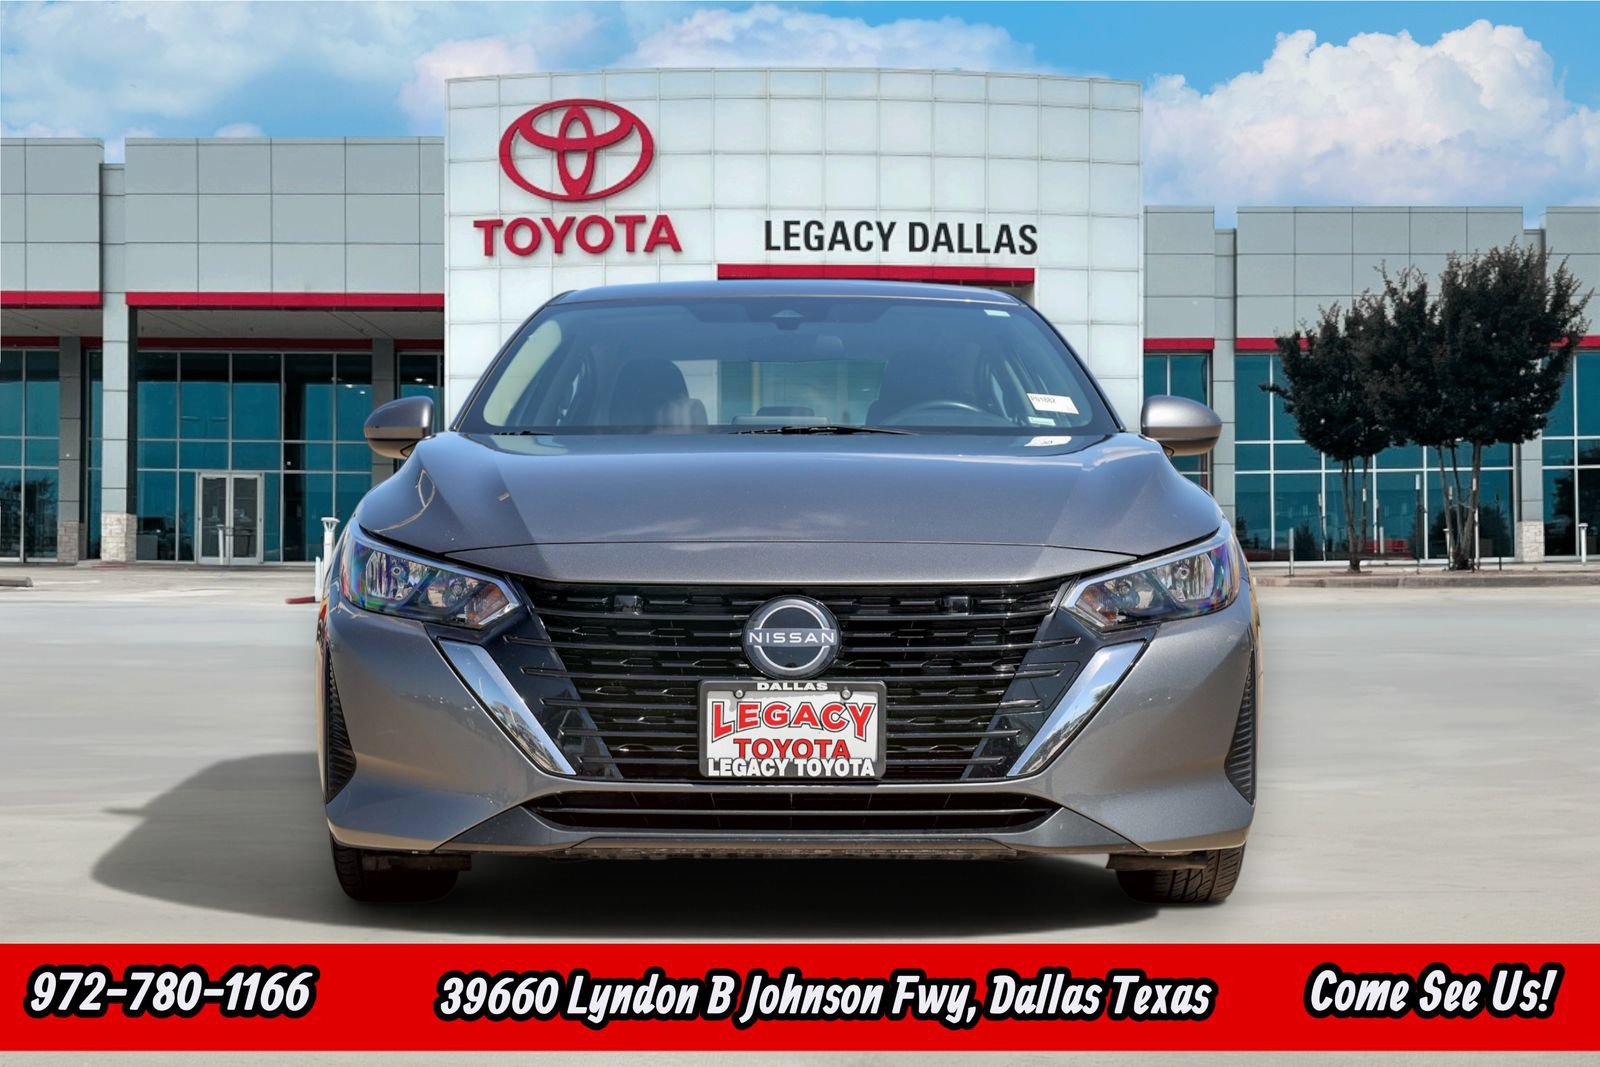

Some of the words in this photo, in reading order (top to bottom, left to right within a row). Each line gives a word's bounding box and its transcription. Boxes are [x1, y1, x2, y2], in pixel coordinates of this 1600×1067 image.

[473, 214, 683, 257] TOYOTA
[764, 220, 896, 251] LEGACY
[908, 221, 1038, 255] DALLAS
[749, 632, 835, 644] NISSAN
[757, 682, 828, 691] DALLAS
[712, 701, 876, 743] LEGACY
[733, 738, 852, 760] TOYOTA
[708, 757, 789, 777] LEGACY
[794, 757, 875, 777] TOYOTA
